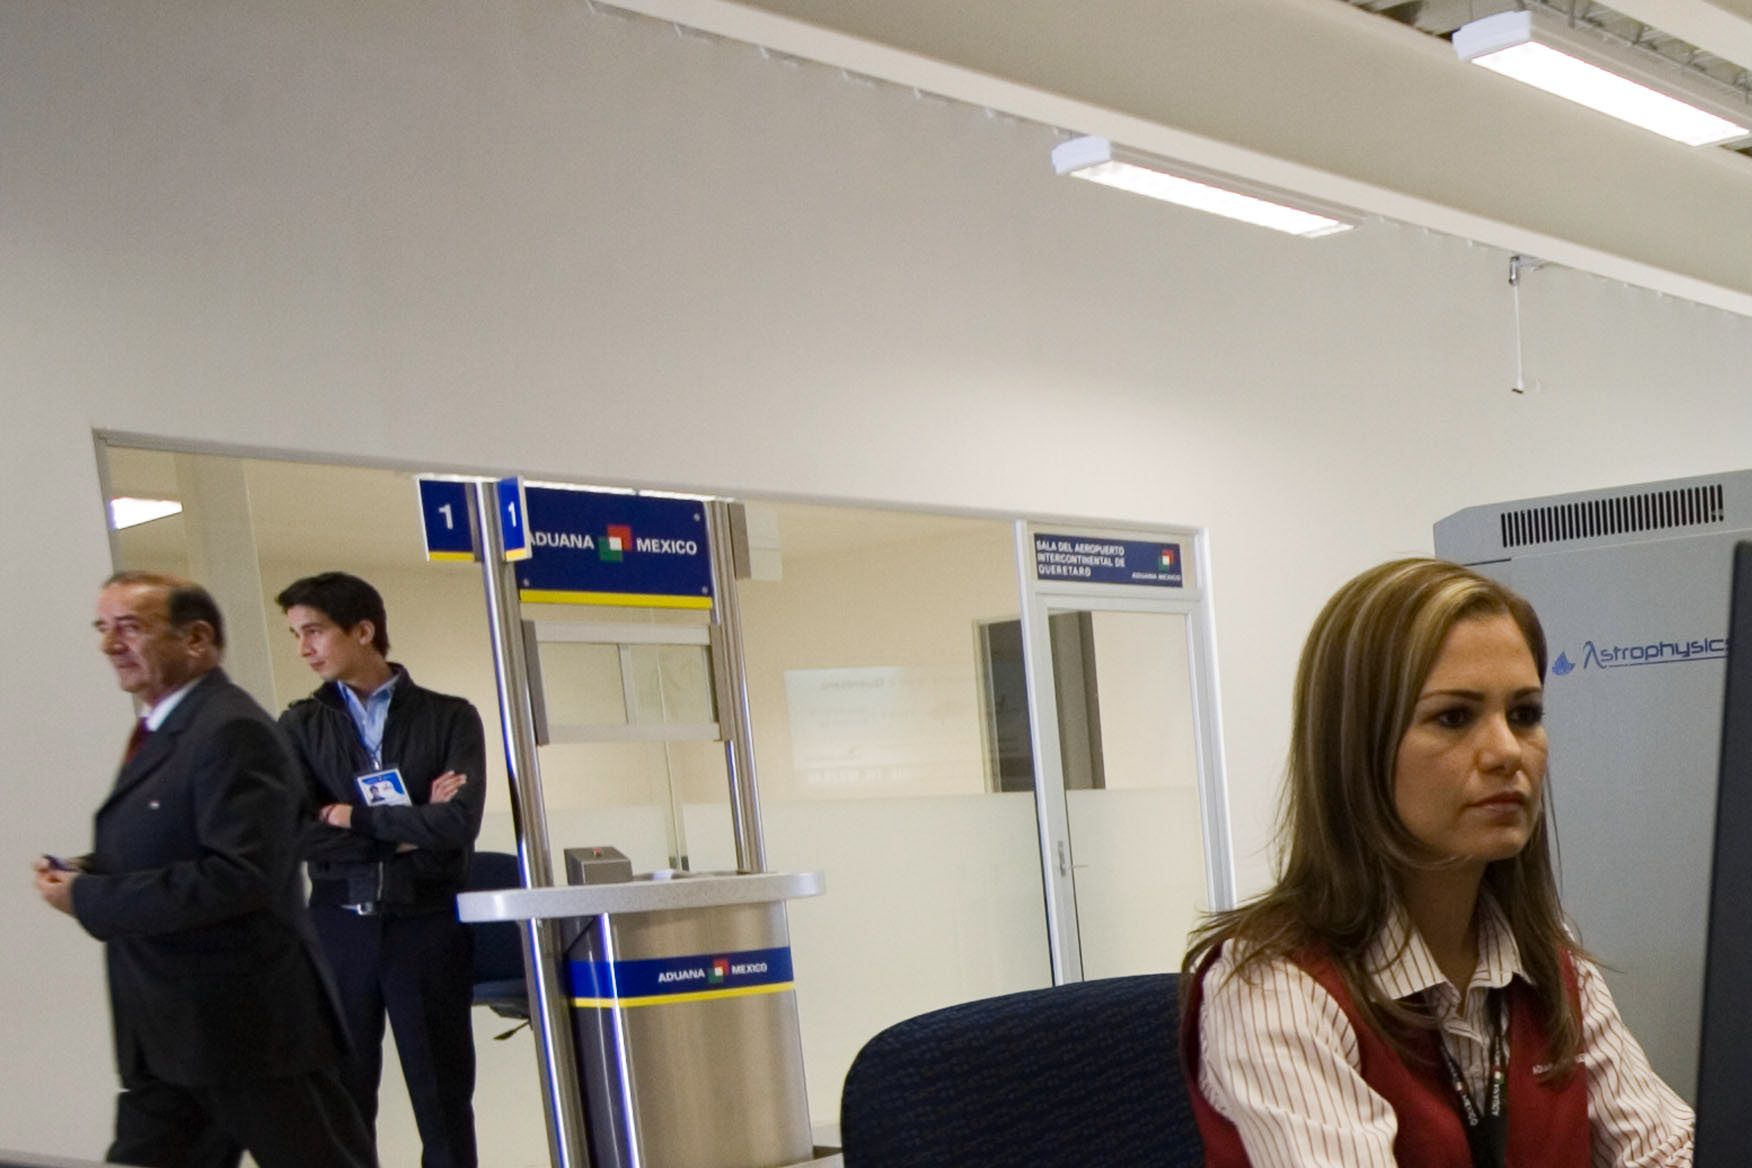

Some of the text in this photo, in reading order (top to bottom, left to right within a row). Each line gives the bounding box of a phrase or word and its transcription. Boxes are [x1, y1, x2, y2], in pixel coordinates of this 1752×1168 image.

[439, 504, 454, 530] 1
[508, 502, 518, 528] 1
[636, 537, 698, 555] MEXICO
[1036, 540, 1125, 556] SALA DEL AEROPUERTO
[1037, 552, 1125, 567] INTERCONTINENTAL DE
[658, 962, 768, 983] ADUANA MEXICO
